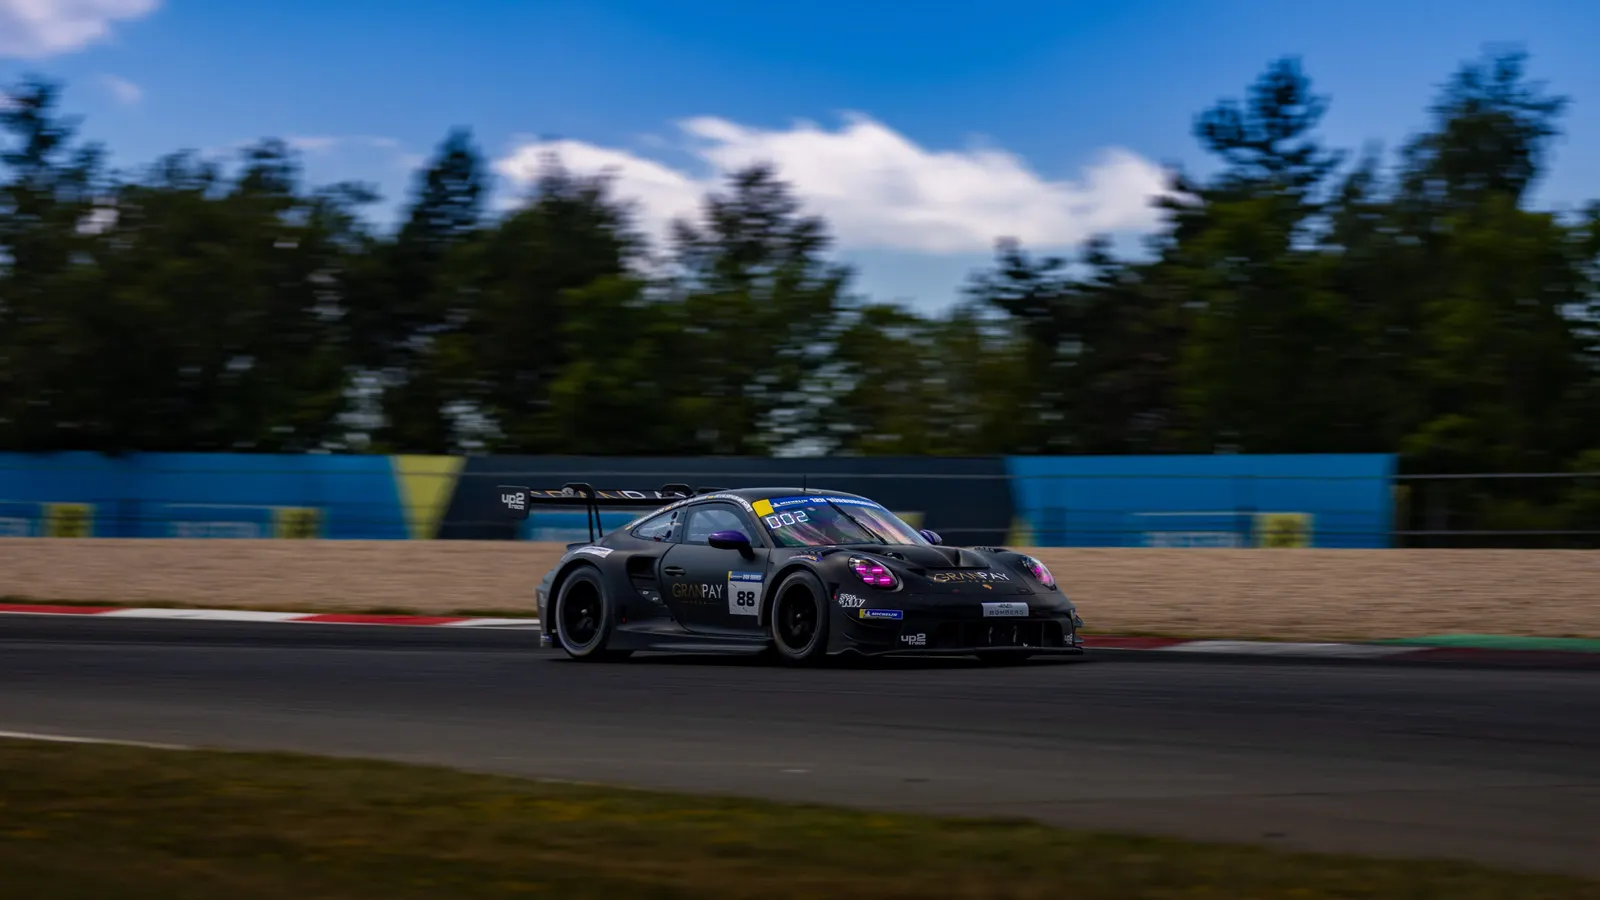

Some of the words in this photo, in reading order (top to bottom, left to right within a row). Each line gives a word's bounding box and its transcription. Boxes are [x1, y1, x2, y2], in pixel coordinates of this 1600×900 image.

[501, 492, 525, 508] up2
[933, 571, 1010, 582] GRANPAY
[672, 583, 723, 599] GRANPAY
[737, 591, 755, 607] 88
[901, 633, 926, 645] up2
